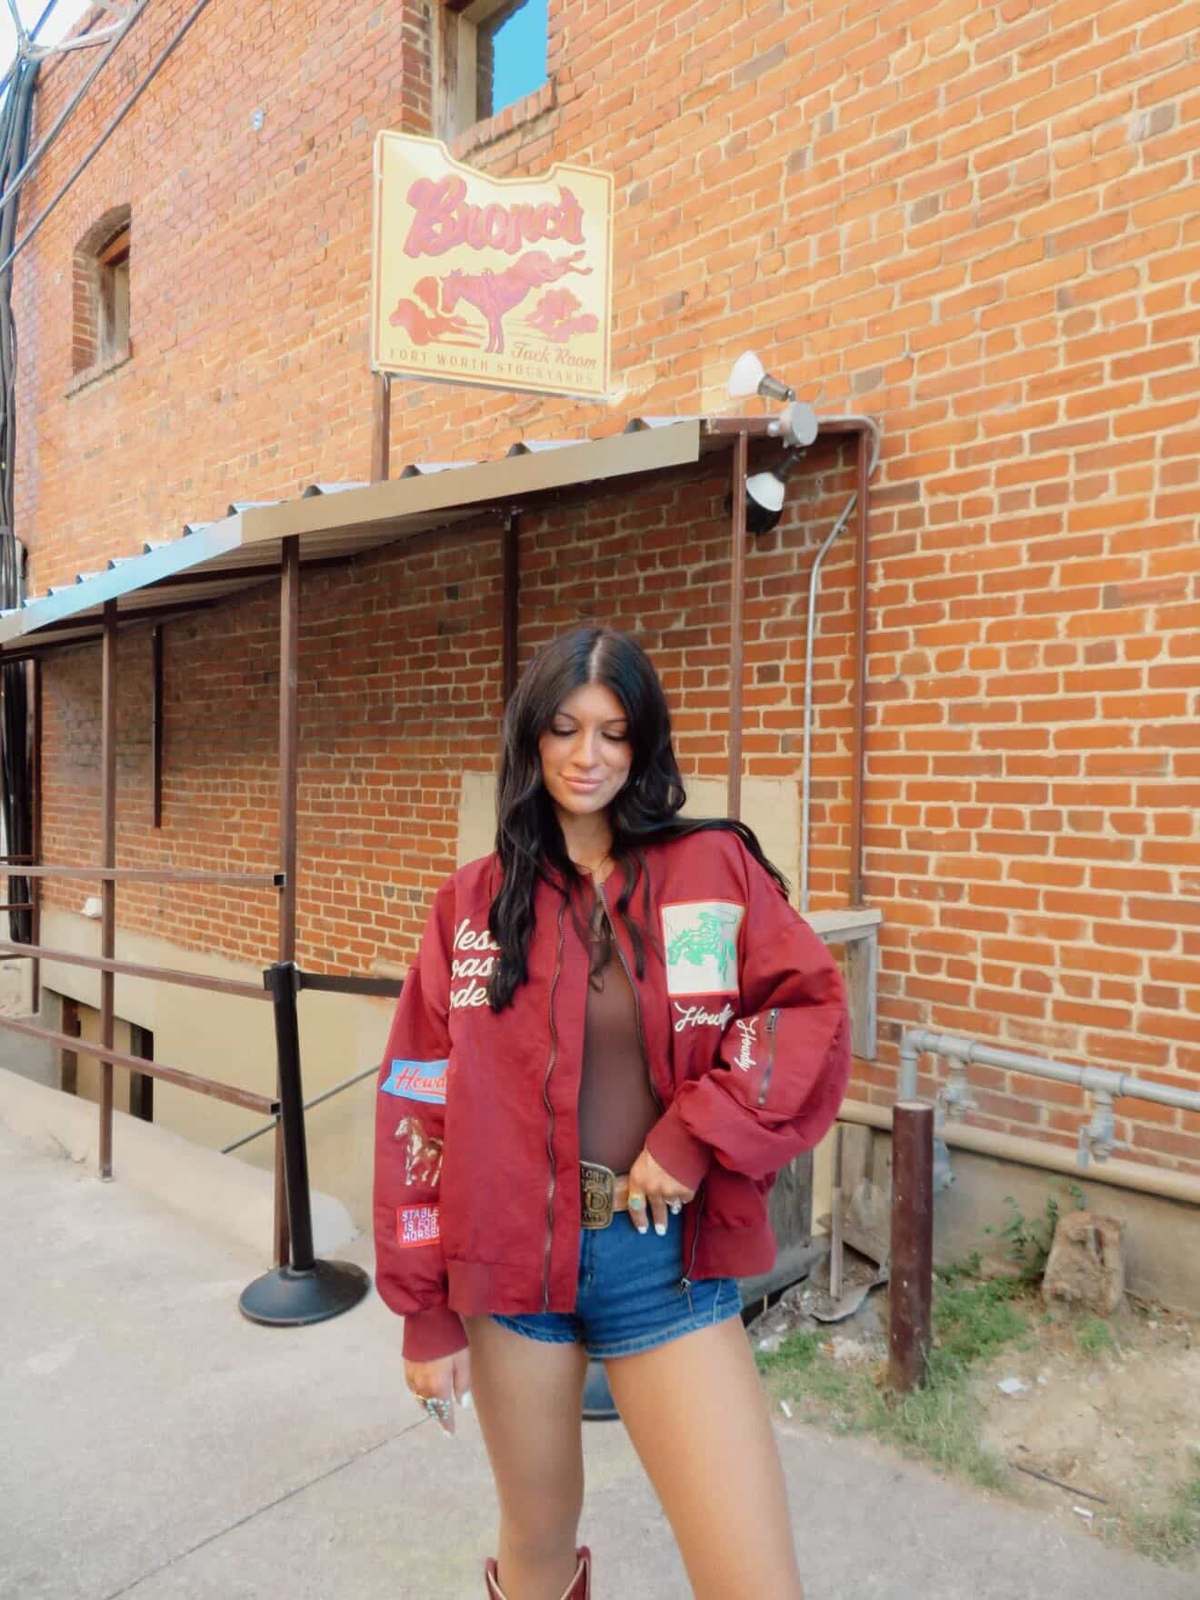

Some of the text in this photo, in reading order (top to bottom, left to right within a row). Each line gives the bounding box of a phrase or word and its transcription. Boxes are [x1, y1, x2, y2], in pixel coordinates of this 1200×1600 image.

[389, 348, 428, 363] FORT
[436, 352, 488, 372] WORTH
[511, 342, 597, 369] Tack Room
